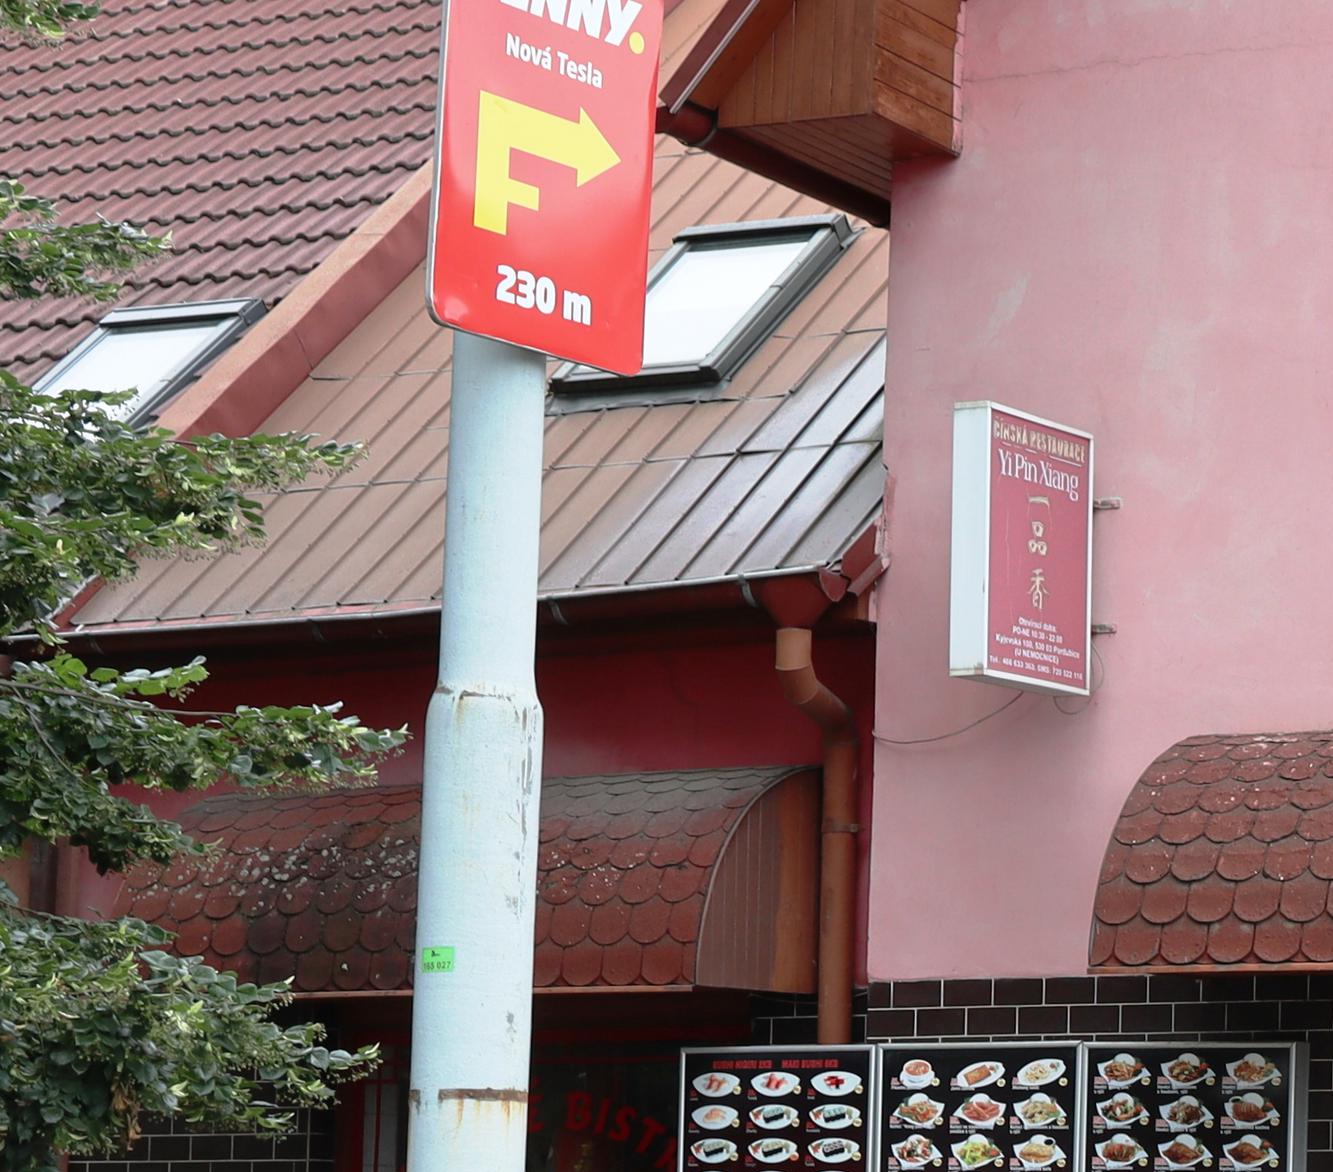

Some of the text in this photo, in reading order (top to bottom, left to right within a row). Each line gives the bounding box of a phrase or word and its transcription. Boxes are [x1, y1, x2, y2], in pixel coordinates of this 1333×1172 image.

[505, 32, 603, 89] Nová Tesla
[496, 264, 592, 326] 230 m
[1029, 430, 1085, 463] RESTAURACE
[998, 448, 1079, 501] Yi Pin Xiang
